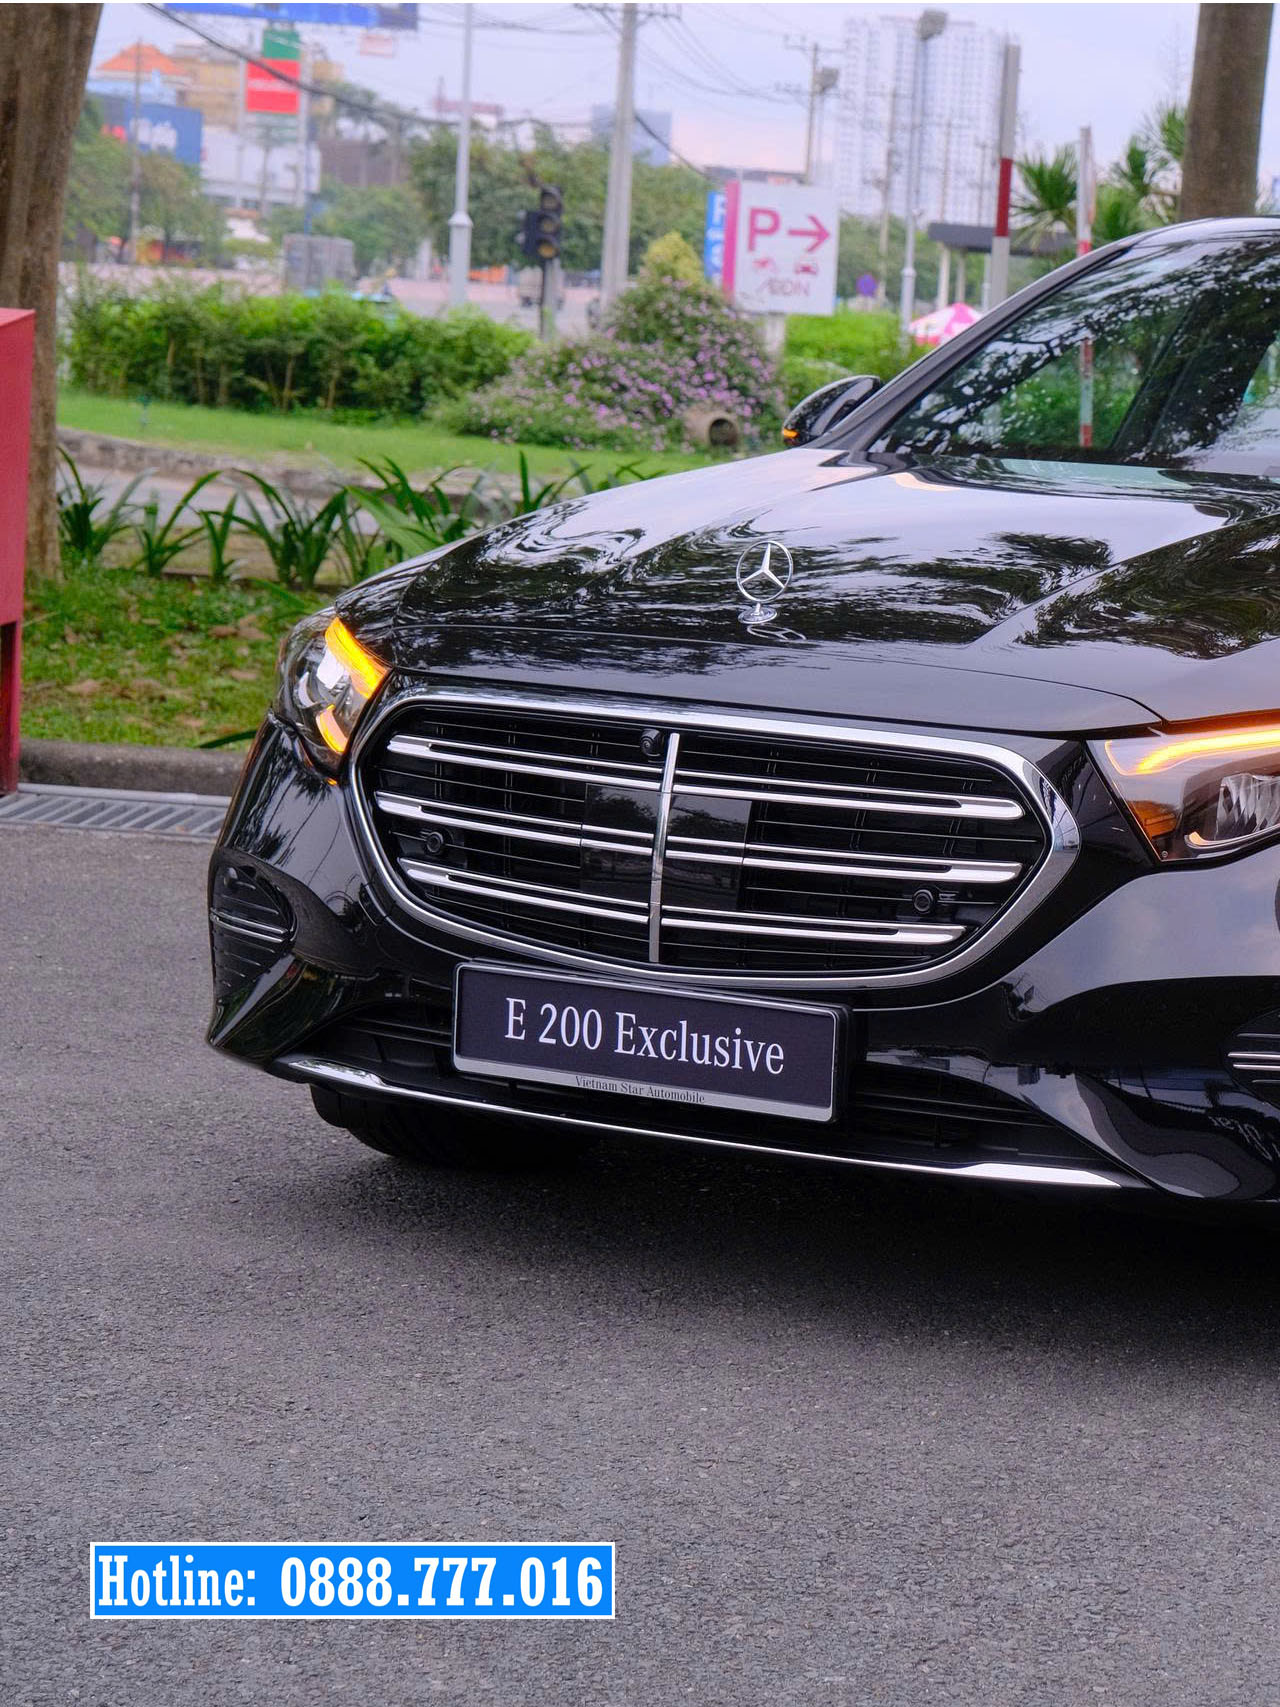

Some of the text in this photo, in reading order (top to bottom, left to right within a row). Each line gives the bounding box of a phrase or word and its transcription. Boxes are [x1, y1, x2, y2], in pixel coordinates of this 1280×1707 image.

[747, 207, 781, 252] P
[504, 997, 785, 1075] E 200 Exclusive
[575, 1075, 705, 1104] Vietnam Star Automobile
